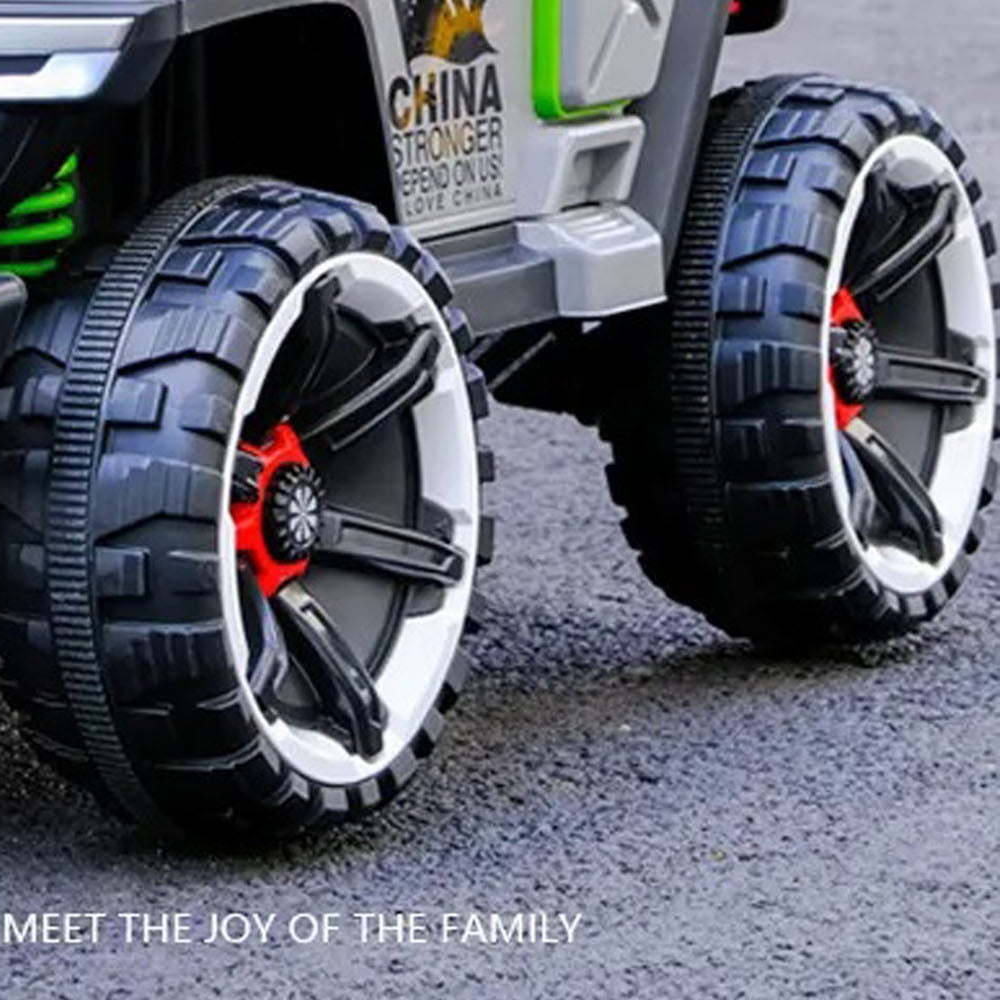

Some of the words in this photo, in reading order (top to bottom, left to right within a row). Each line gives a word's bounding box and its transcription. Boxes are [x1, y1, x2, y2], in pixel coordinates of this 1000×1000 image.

[389, 64, 502, 131] CHINA
[392, 117, 502, 170] STRONGER
[453, 159, 477, 186] ON
[404, 192, 445, 217] LOVE
[453, 183, 502, 207] CHINA
